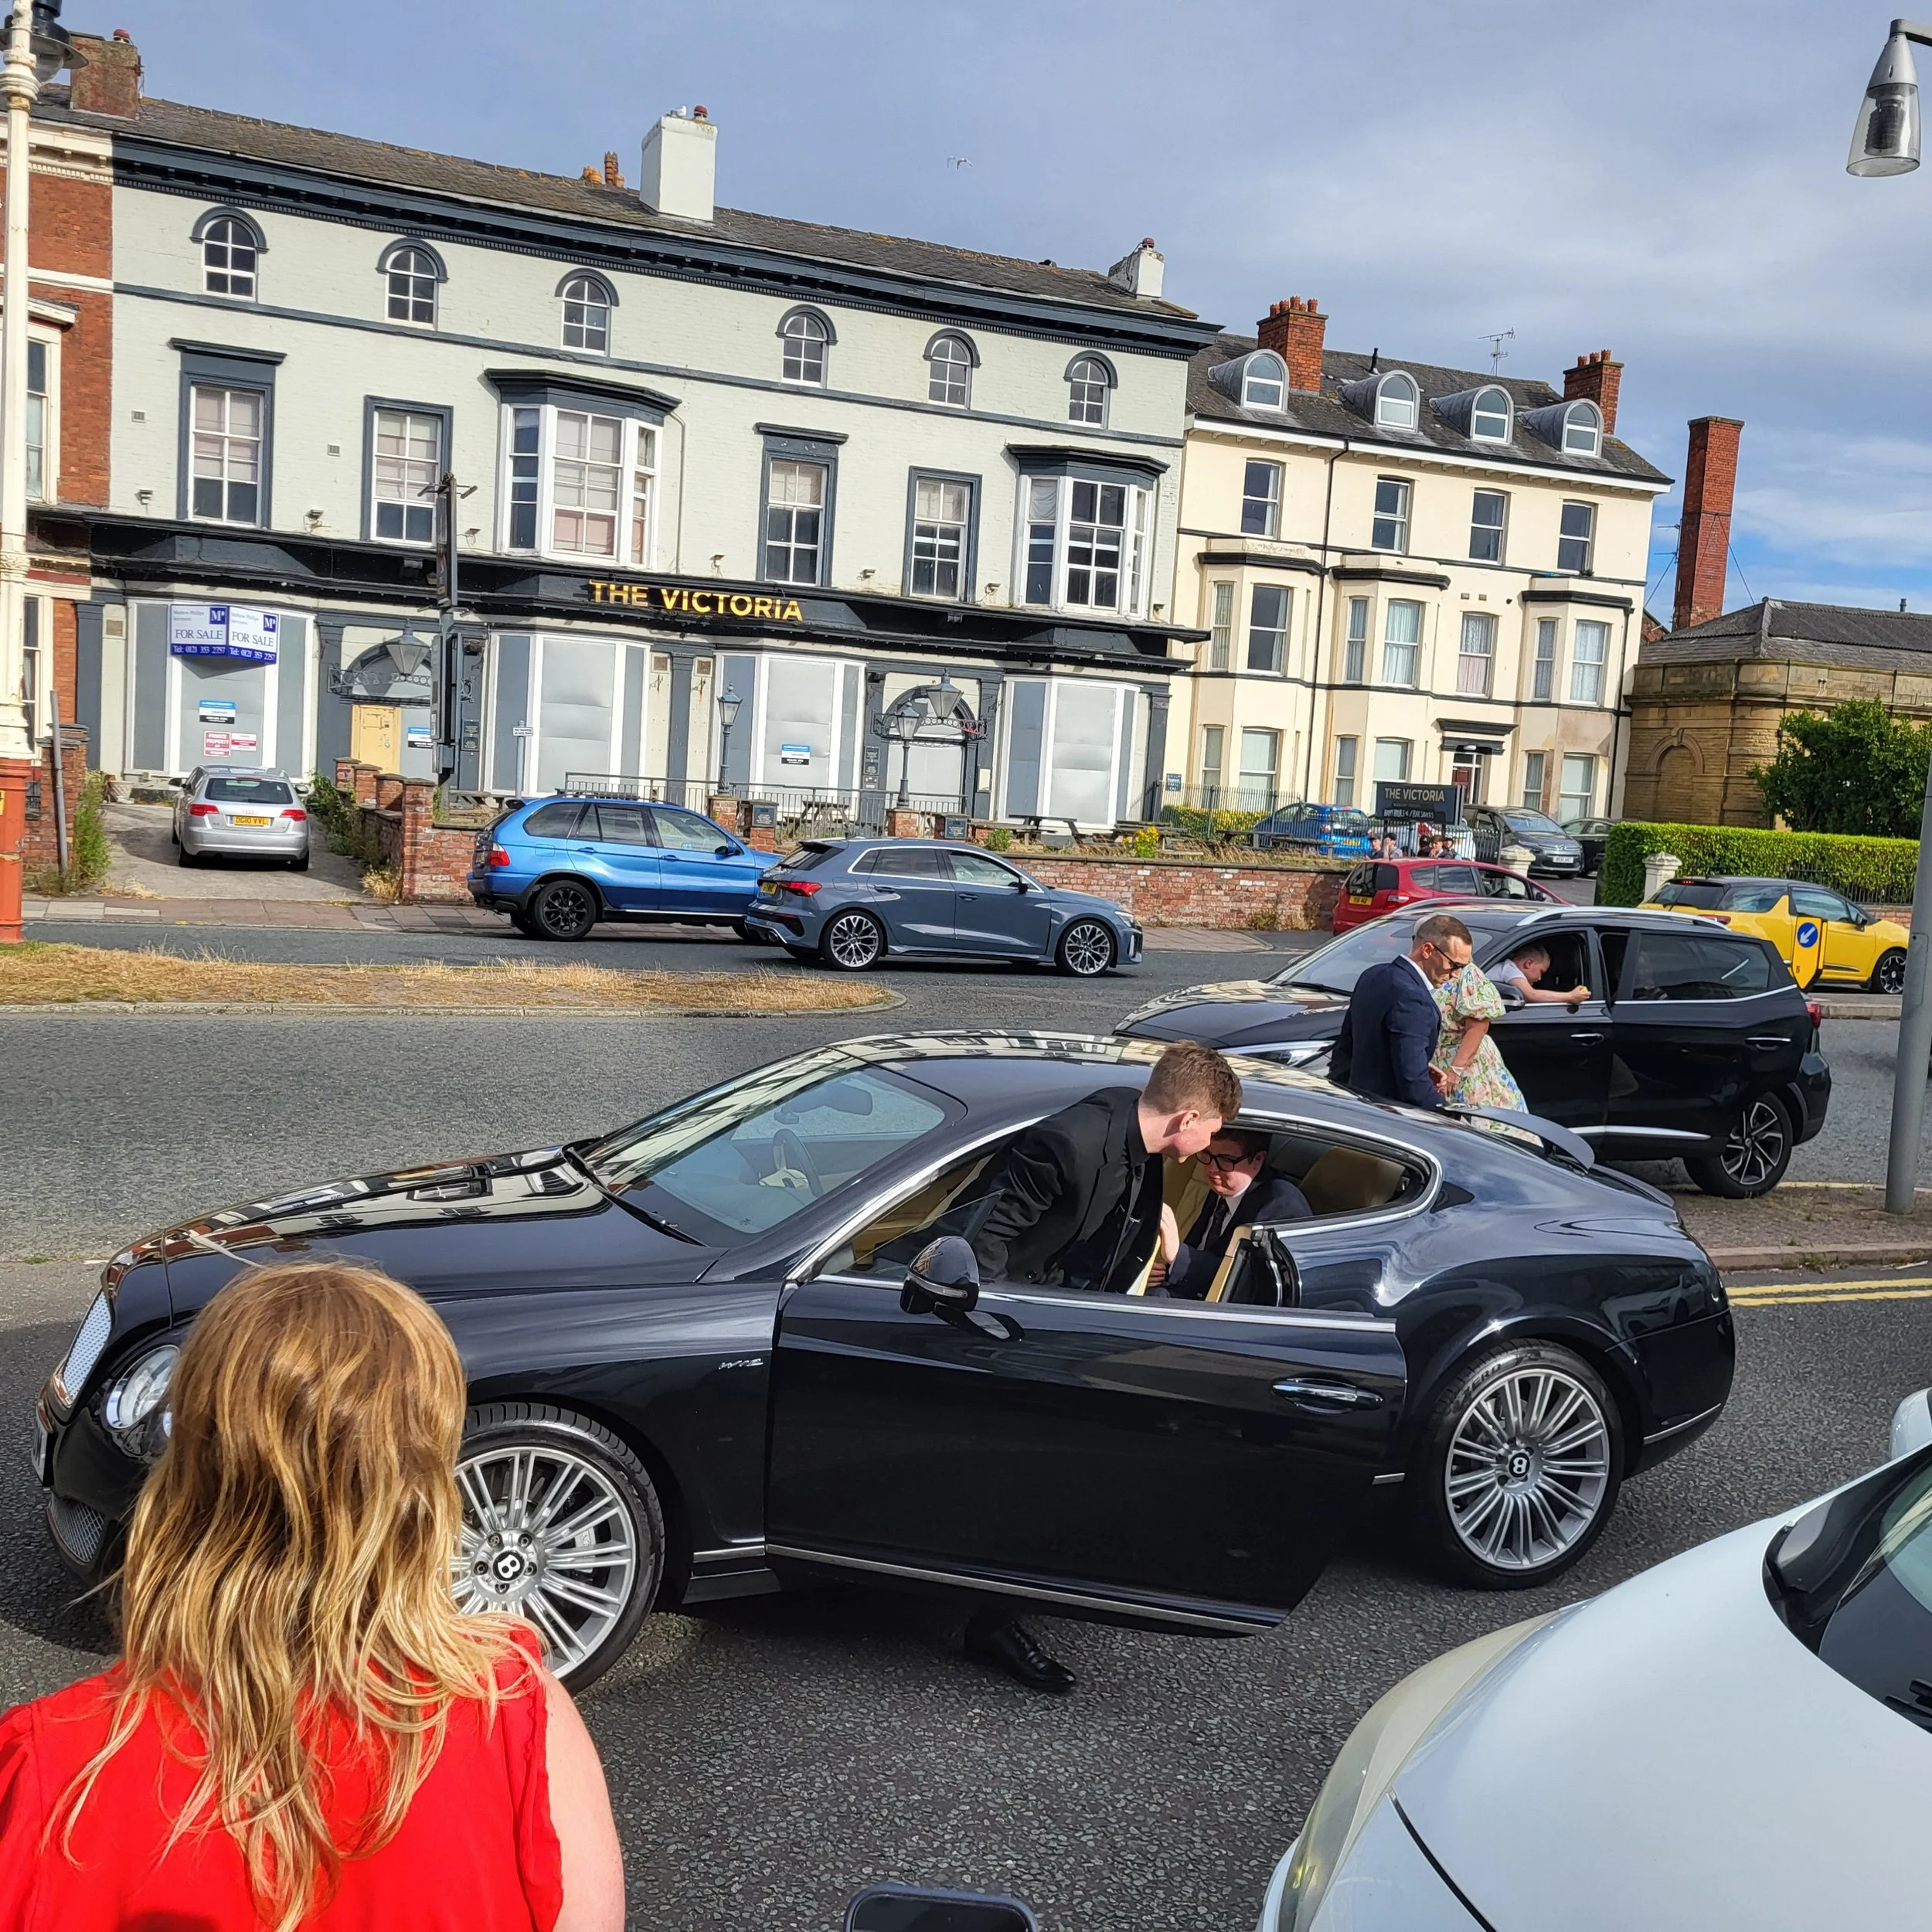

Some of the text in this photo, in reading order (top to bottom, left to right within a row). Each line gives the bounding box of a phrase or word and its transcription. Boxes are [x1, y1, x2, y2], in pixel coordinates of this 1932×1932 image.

[589, 579, 803, 622] THE VICTORIA
[175, 629, 223, 640] FOR SALE
[232, 631, 274, 647] FOR SALE
[1385, 787, 1444, 801] THE VICTORIA
